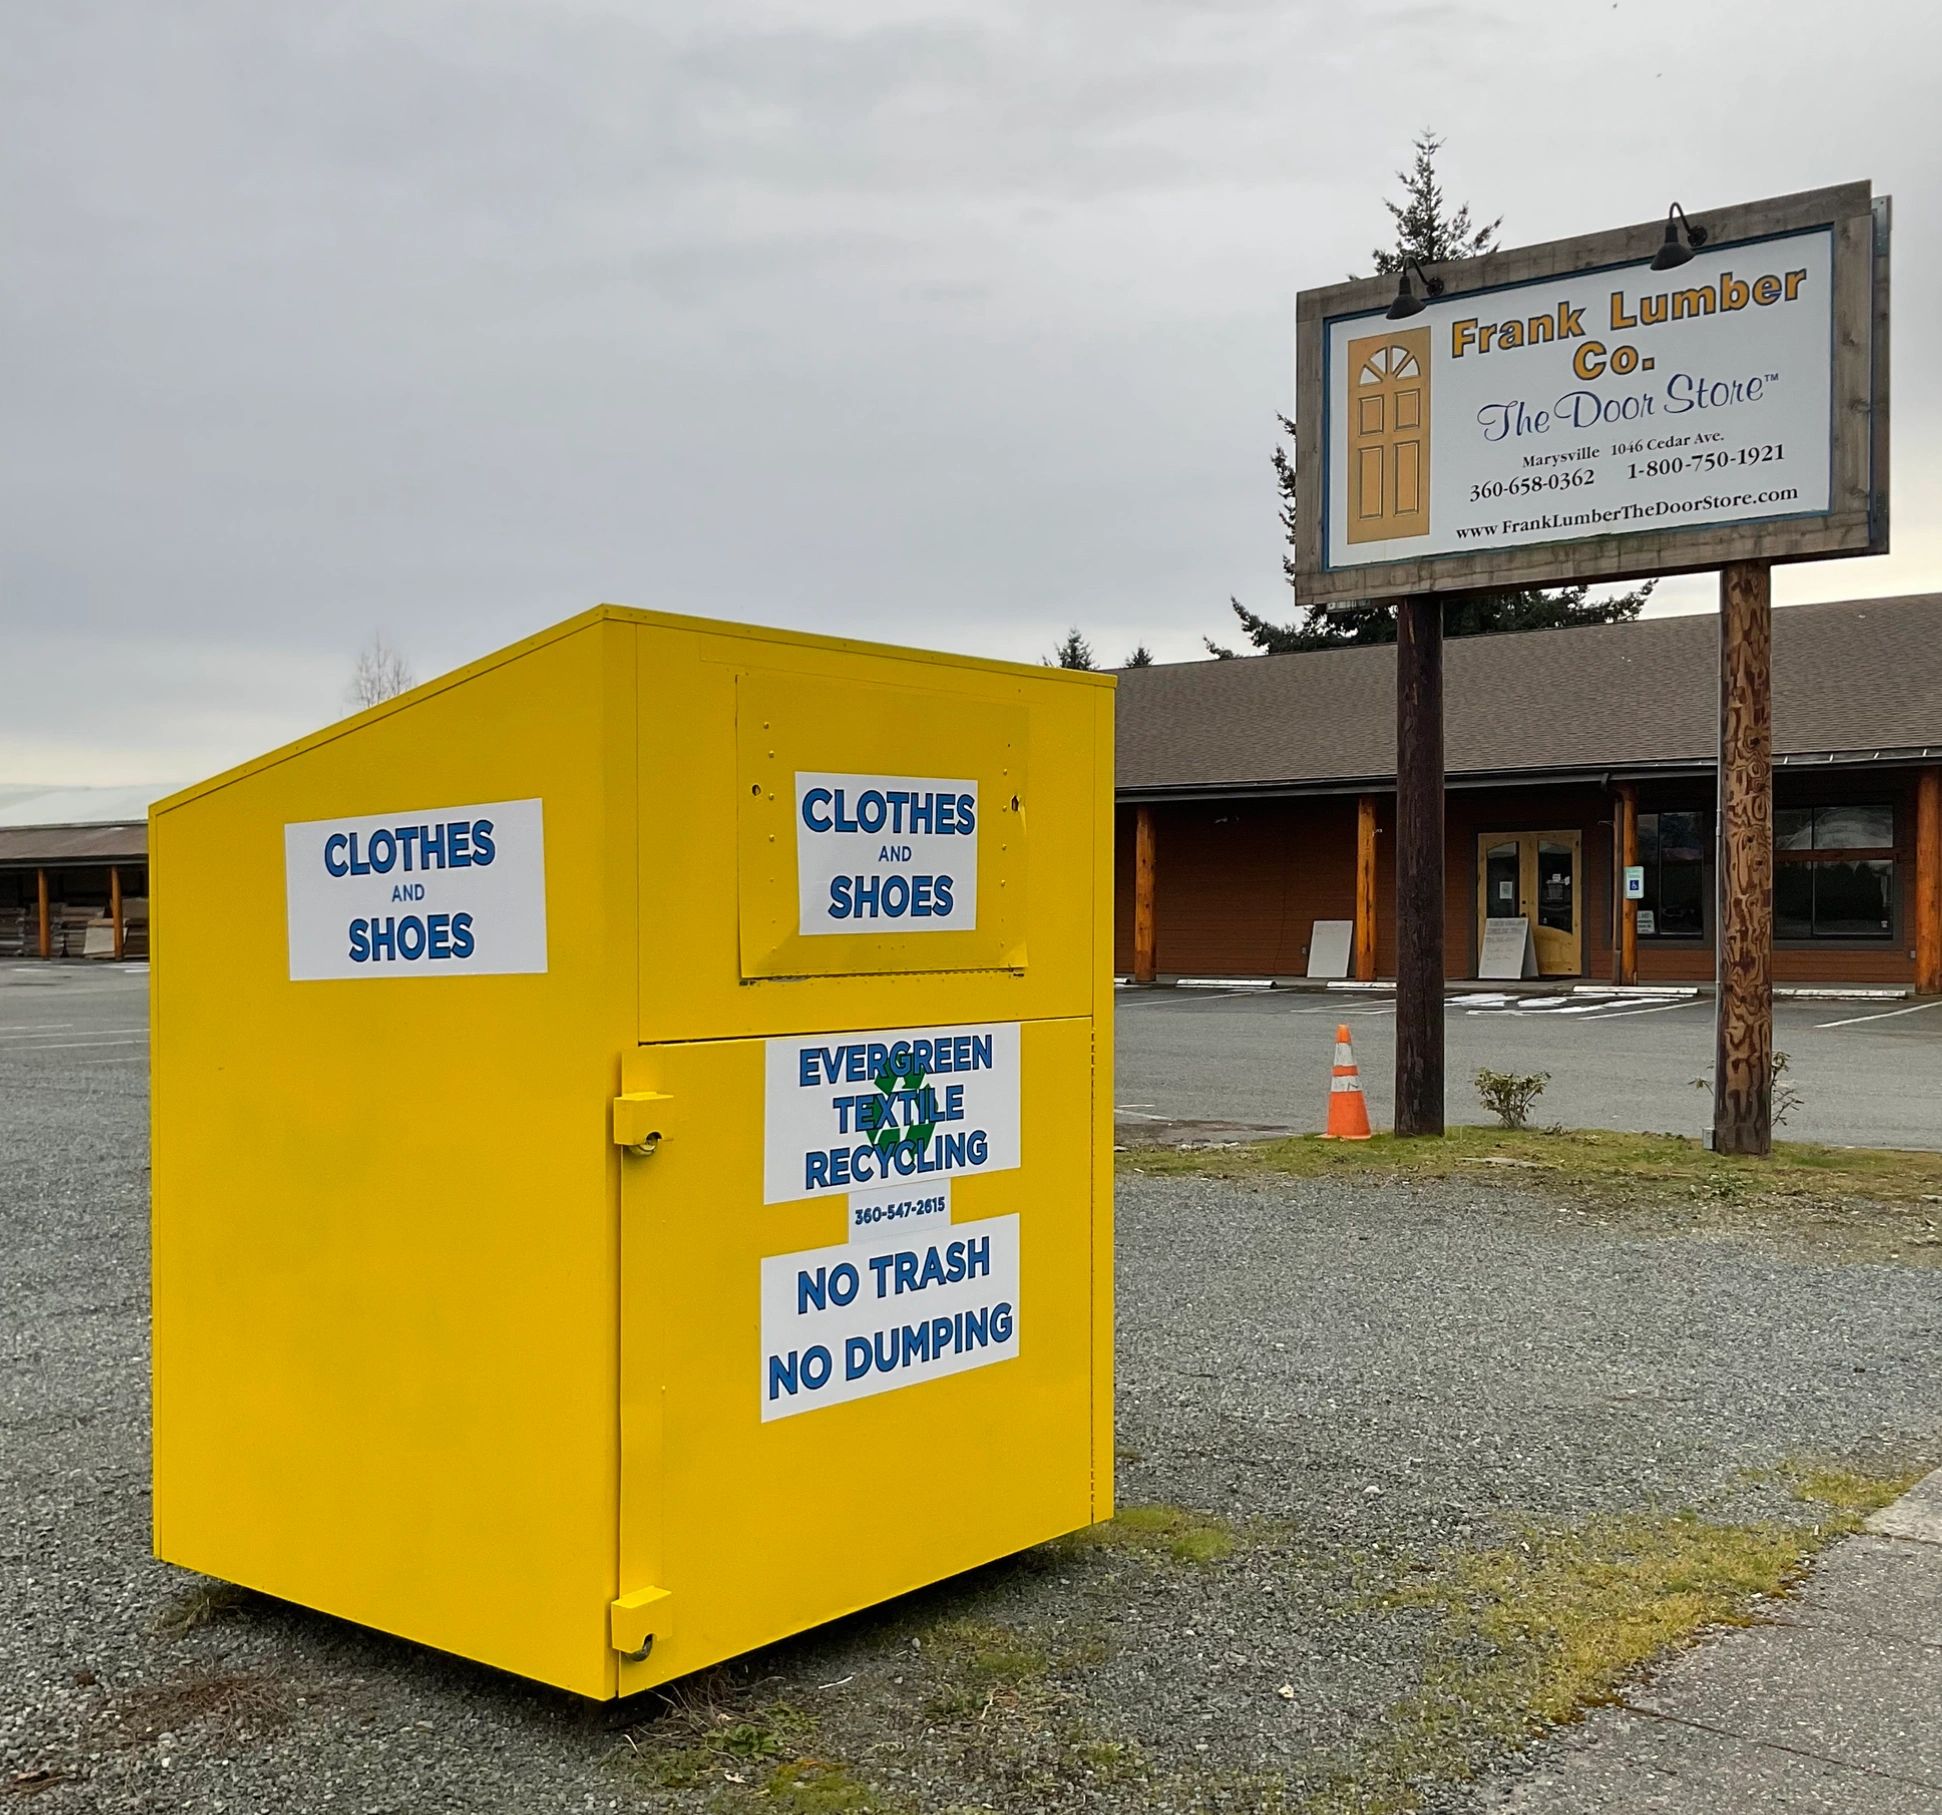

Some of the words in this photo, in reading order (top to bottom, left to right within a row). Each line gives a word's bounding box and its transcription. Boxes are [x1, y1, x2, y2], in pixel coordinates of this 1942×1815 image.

[1452, 301, 1587, 358] Frank
[1610, 268, 1807, 331] Lumber
[1573, 340, 1655, 381] Co.
[1477, 401, 1550, 441] The
[1553, 391, 1655, 428] Door
[1469, 467, 1595, 502] 360-658-0362
[1627, 443, 1785, 480] 1-800-750-1921
[1522, 446, 1600, 468] Marysville
[1610, 439, 1644, 456] 1046
[1647, 434, 1691, 451] Cedar
[1694, 431, 1725, 444] Ave.
[801, 787, 976, 836] CLOTHES
[324, 819, 496, 877] CLOTHES
[878, 845, 912, 862] AND
[391, 883, 426, 902] AND
[828, 874, 954, 919] SHOES
[349, 912, 475, 962] SHOES
[799, 1034, 993, 1086] EVERGREEN
[833, 1084, 964, 1134] TEXTILE
[805, 1130, 988, 1190] RECYCLING
[855, 1196, 946, 1226] 360-547-2615
[797, 1262, 860, 1315] NO
[869, 1235, 990, 1299] TRASH
[768, 1344, 833, 1401] NO
[845, 1302, 1013, 1381] DUMPING
